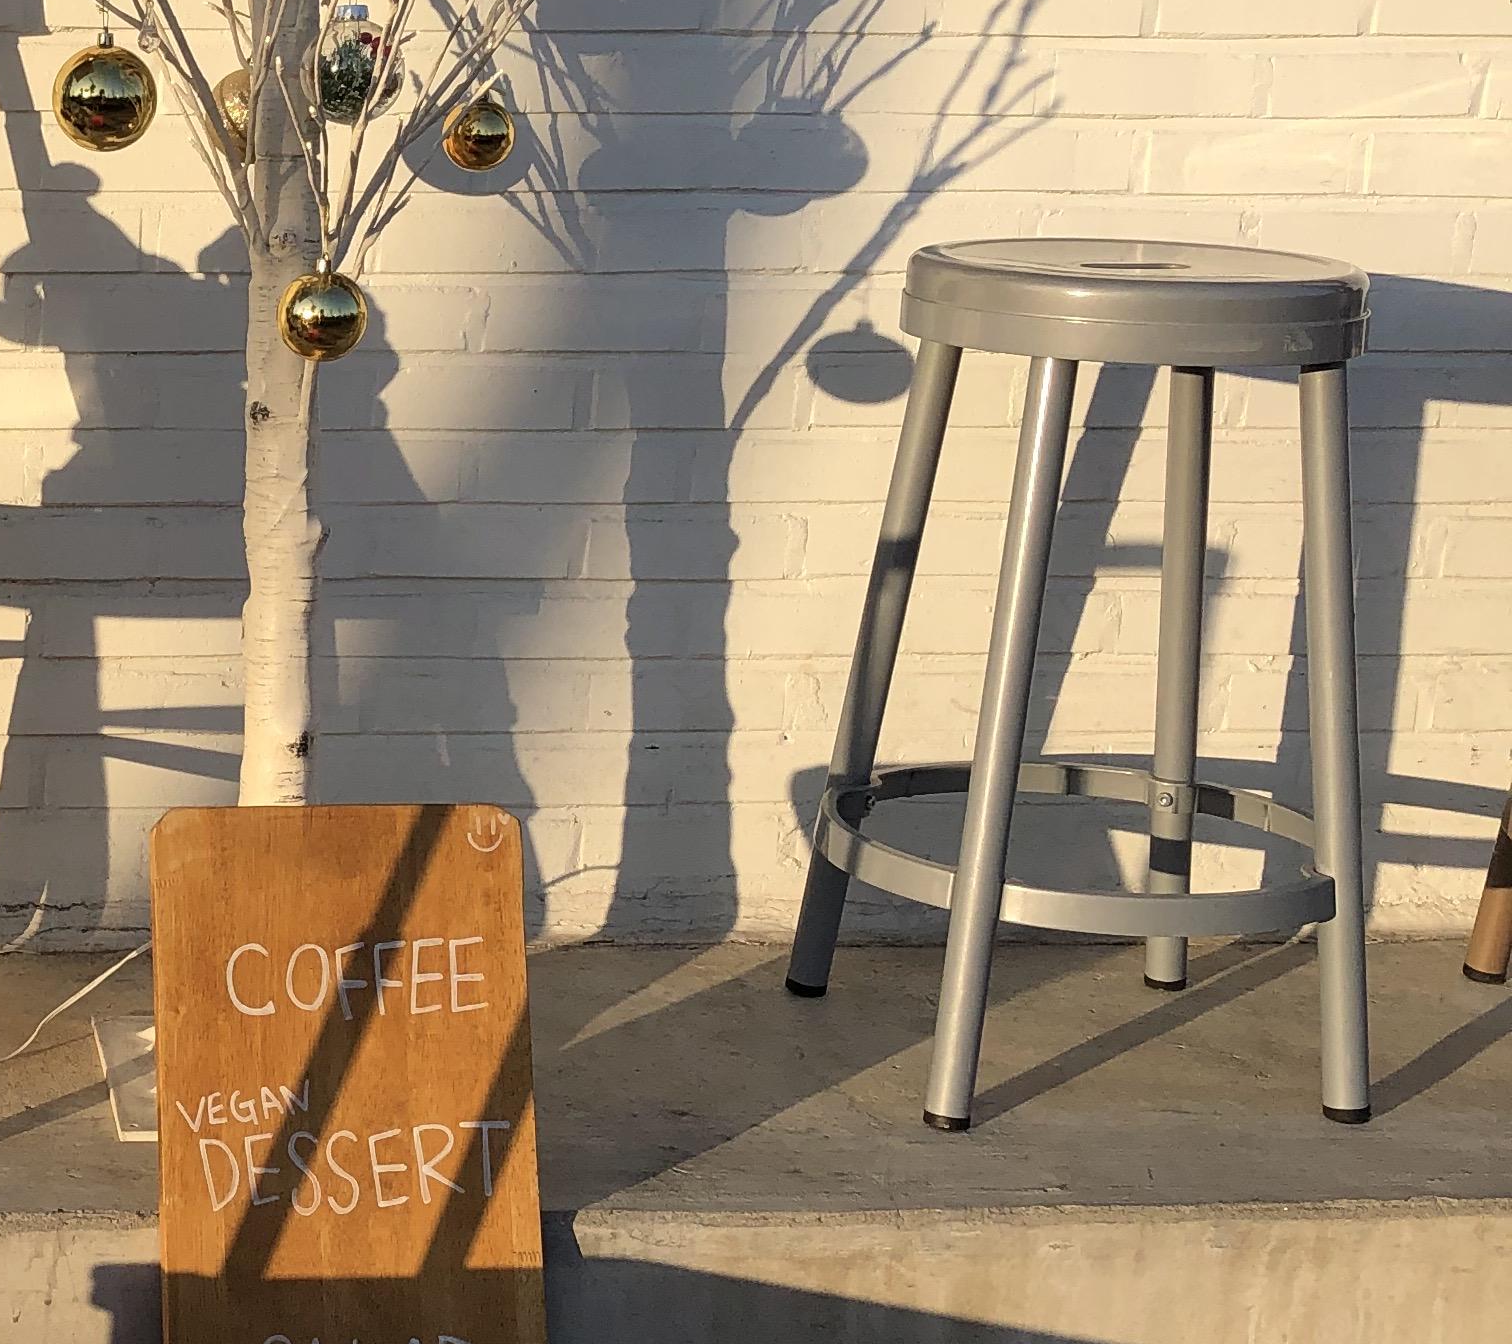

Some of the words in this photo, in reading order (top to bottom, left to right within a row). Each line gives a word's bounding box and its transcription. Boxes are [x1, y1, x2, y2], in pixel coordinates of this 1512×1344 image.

[225, 936, 489, 1021] COFFEE
[176, 1079, 310, 1133] VEGAN
[199, 1120, 511, 1217] DESSERT
